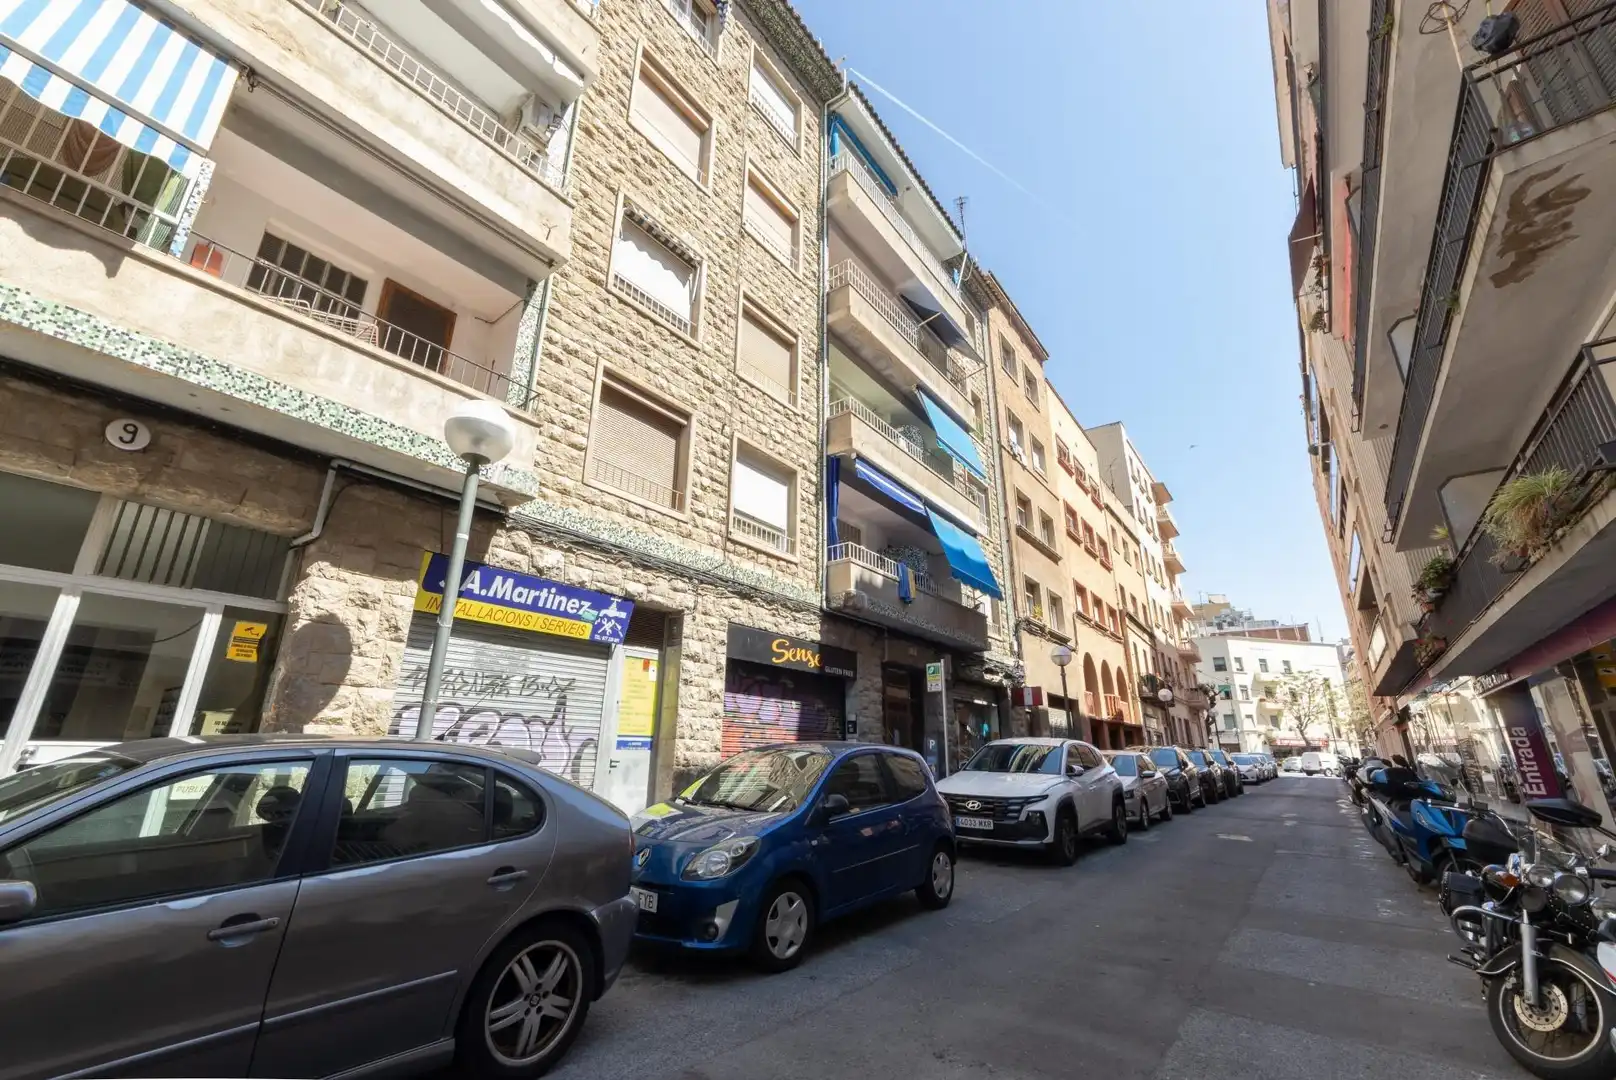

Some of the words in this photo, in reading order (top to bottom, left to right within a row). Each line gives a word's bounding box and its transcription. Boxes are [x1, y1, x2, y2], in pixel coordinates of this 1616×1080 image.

[118, 423, 139, 444] 9
[540, 617, 588, 637] SERVEIS
[771, 638, 824, 668] Sense
[1509, 726, 1548, 796] Entrada
[960, 818, 977, 827] 4033
